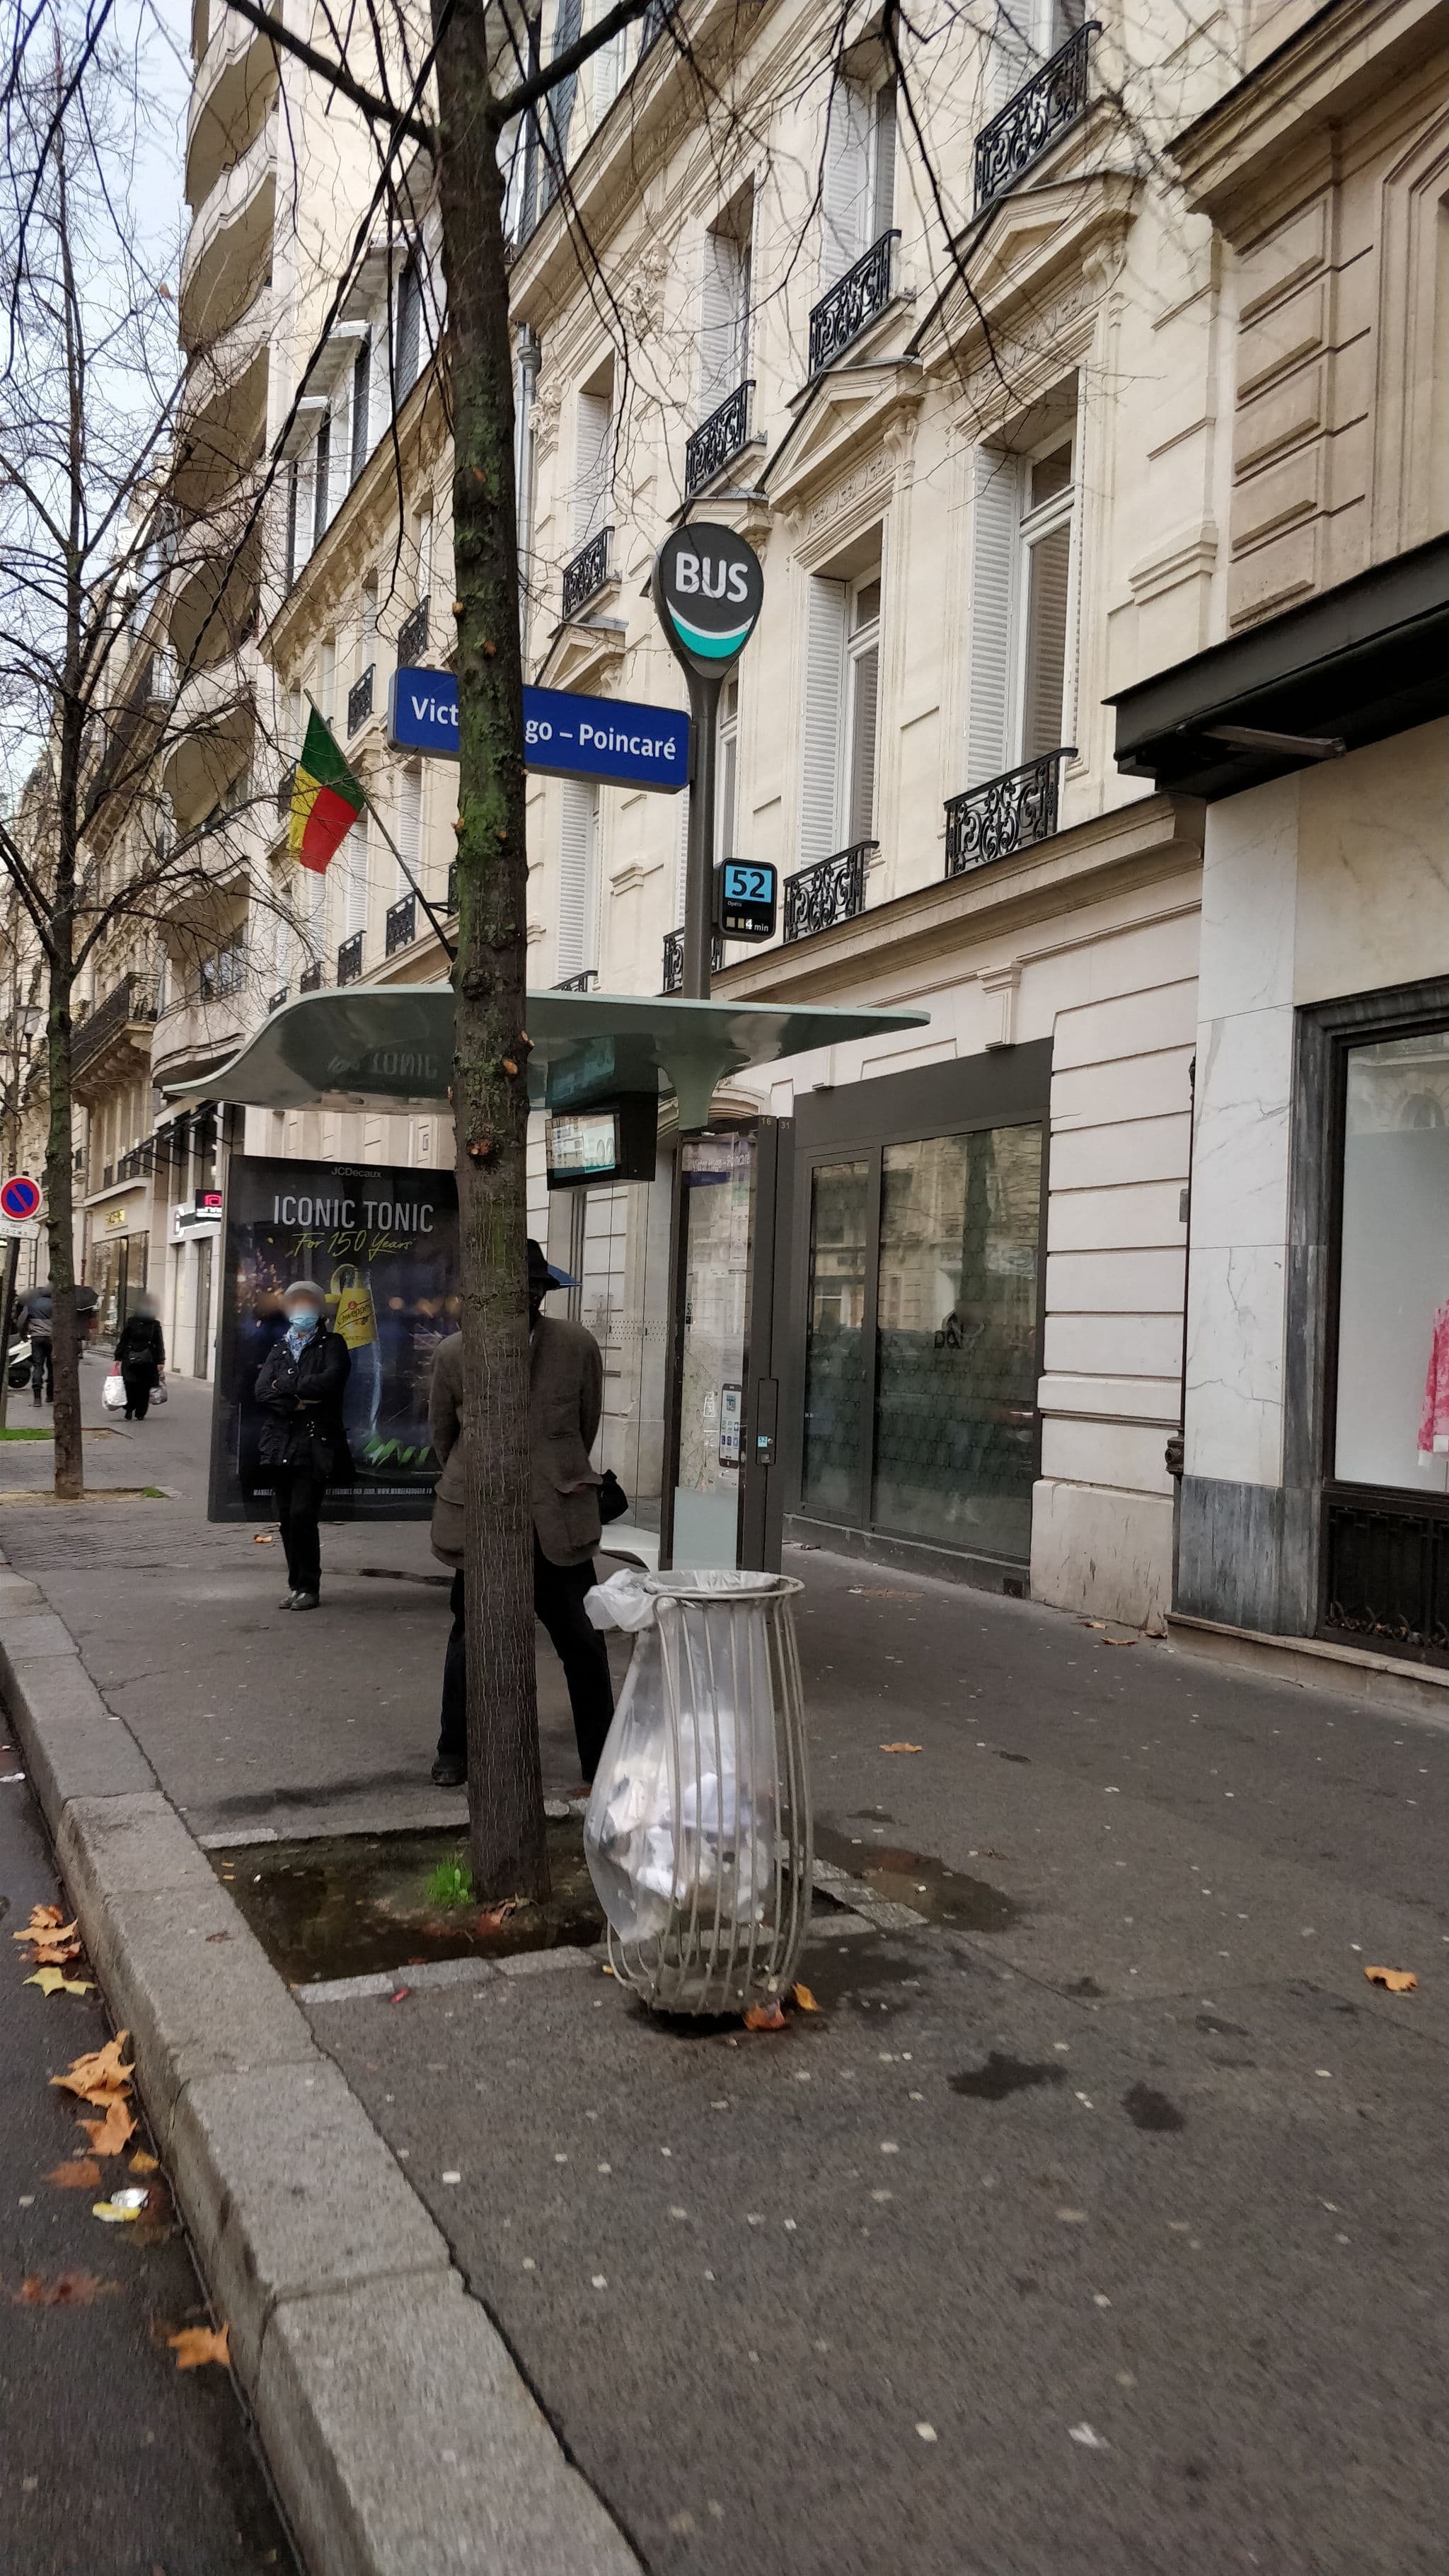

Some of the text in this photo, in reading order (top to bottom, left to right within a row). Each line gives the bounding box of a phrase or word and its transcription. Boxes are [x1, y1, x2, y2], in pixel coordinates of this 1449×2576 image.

[675, 552, 749, 603] BUS
[411, 696, 459, 727] Vict
[525, 720, 553, 744] go
[579, 723, 676, 761] Poincaré
[731, 869, 765, 898] 52
[754, 924, 769, 932] min
[780, 1121, 790, 1129] 31
[331, 1167, 382, 1178] JCDecaux
[274, 1195, 434, 1233] ICONIC TONIC
[291, 1232, 325, 1257] For
[327, 1230, 366, 1257] 150
